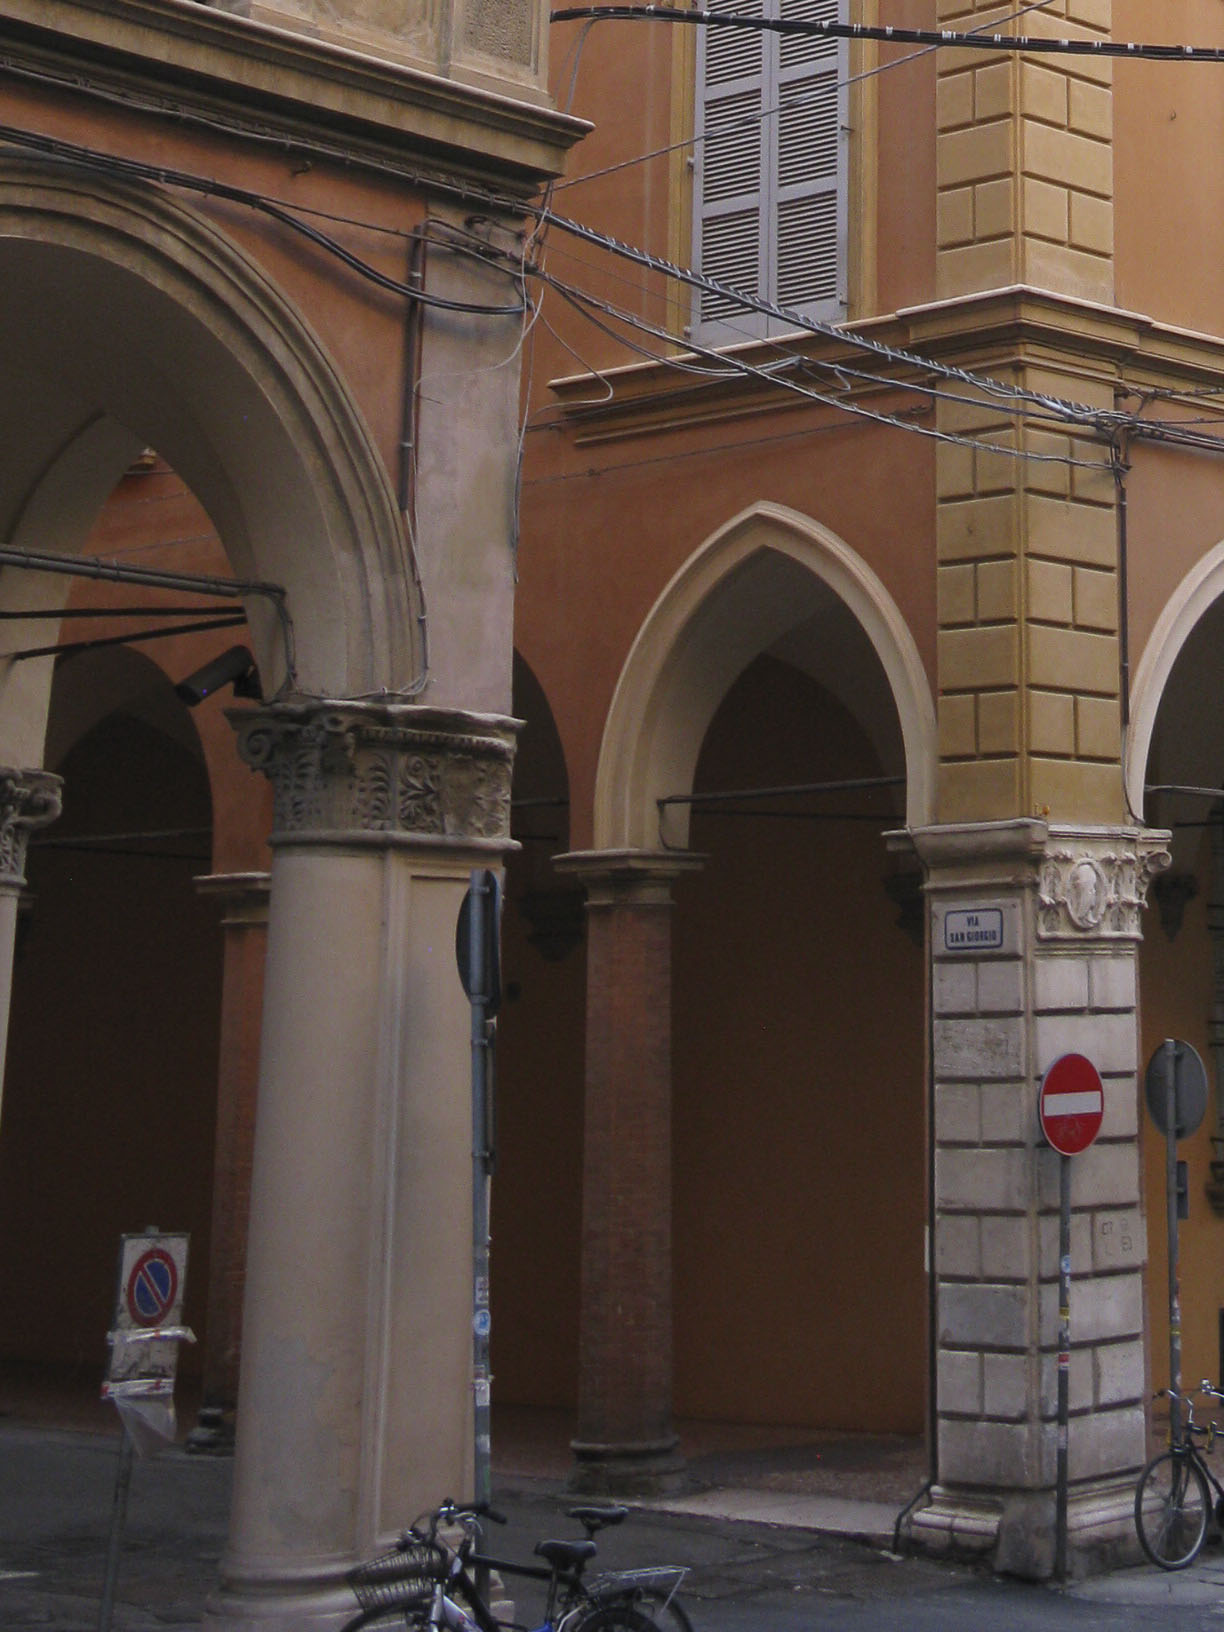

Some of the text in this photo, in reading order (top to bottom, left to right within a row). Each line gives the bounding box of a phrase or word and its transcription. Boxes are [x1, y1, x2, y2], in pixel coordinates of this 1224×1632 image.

[967, 916, 979, 927] VIA
[950, 930, 997, 943] SAN GIORGIO
